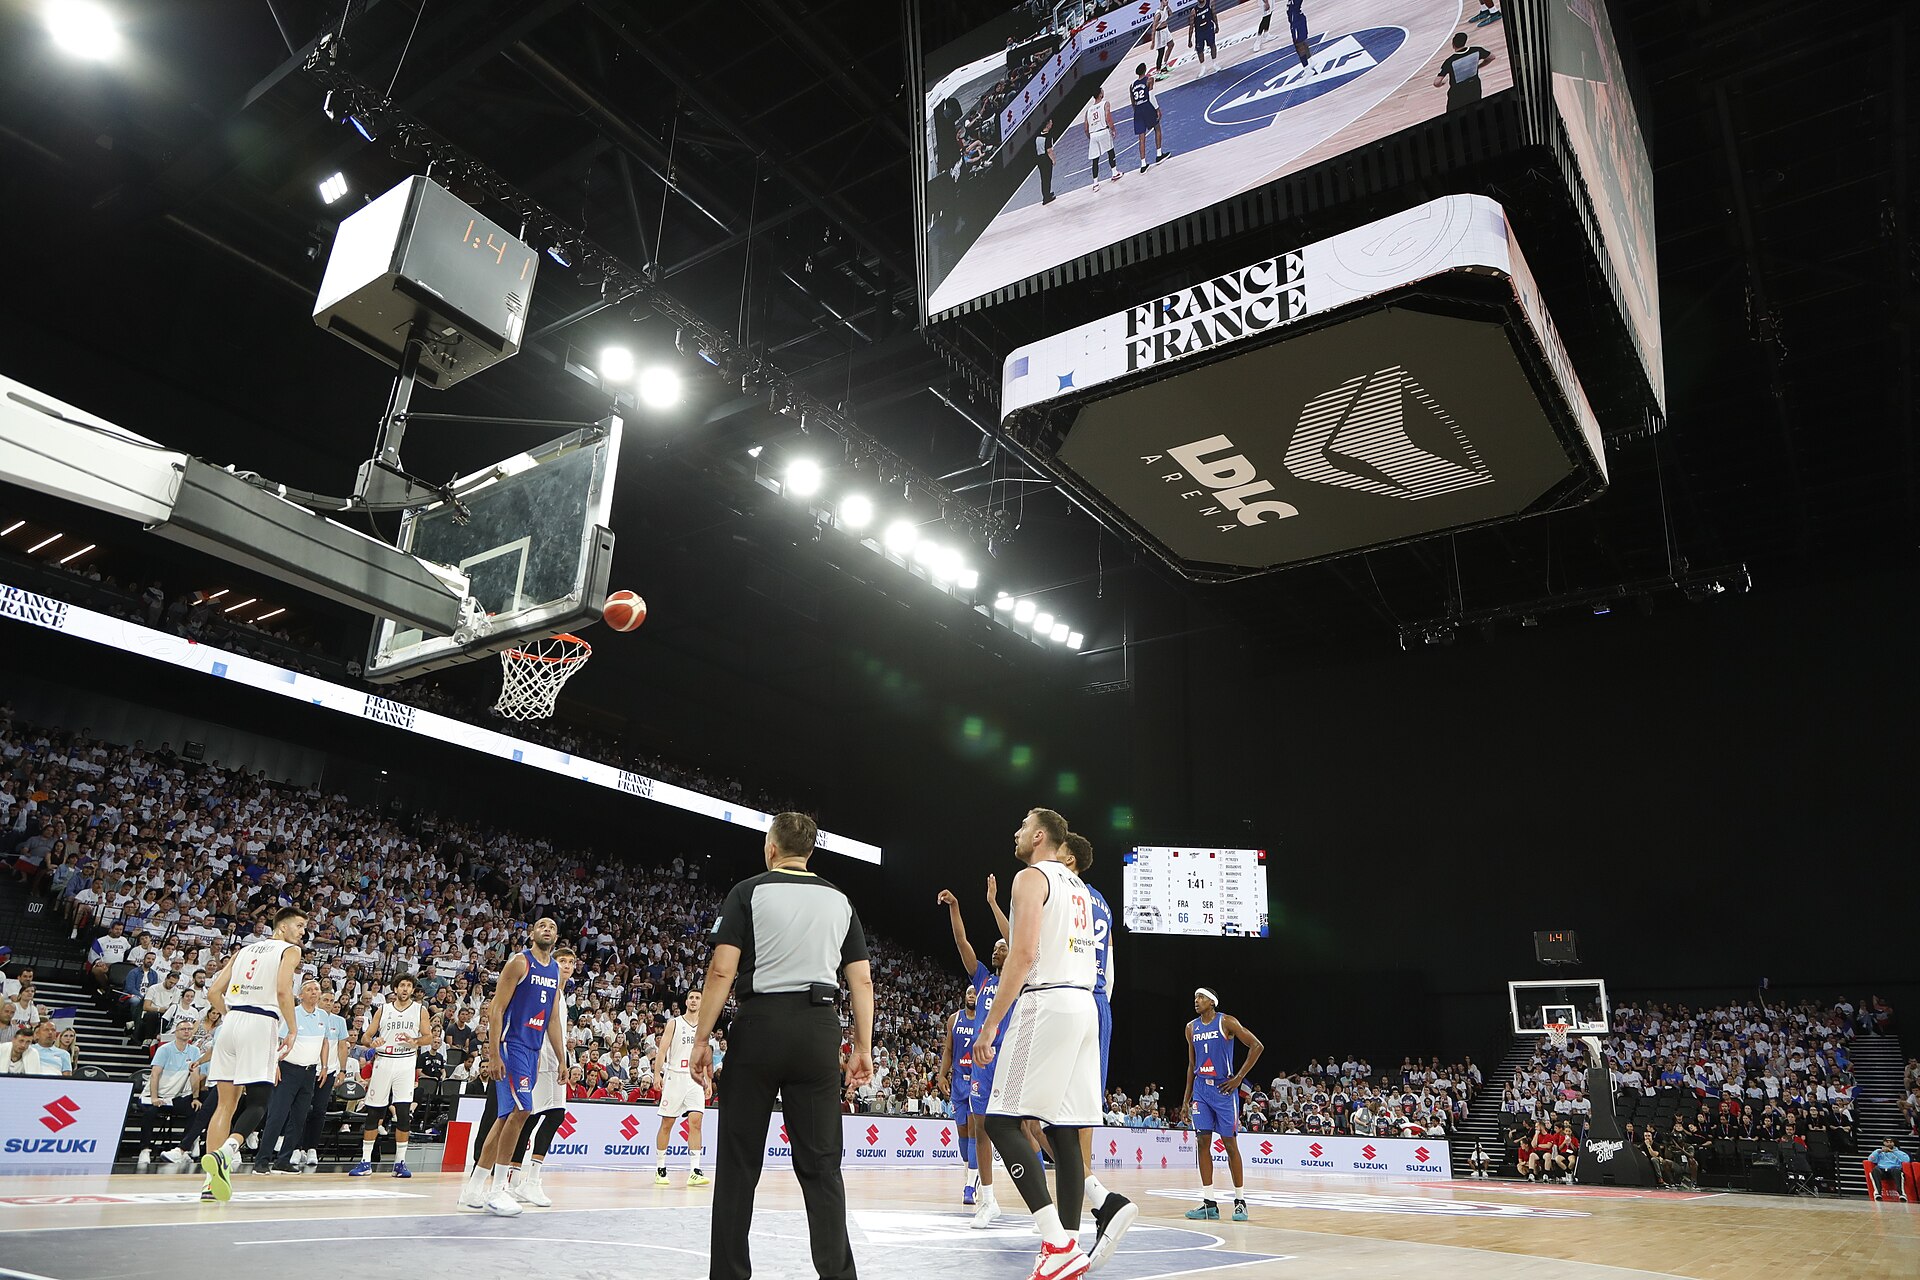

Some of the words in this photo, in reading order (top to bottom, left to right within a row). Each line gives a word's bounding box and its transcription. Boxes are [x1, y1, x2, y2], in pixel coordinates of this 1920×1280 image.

[1088, 29, 1117, 44] SUZUKI
[1133, 89, 1145, 100] 32
[463, 219, 531, 281] 1:41
[1125, 249, 1305, 339] FRANCE
[1125, 285, 1307, 372] FRANCE
[1166, 433, 1300, 527] LDLC
[1140, 453, 1238, 533] ARENA
[0, 585, 69, 615] RANCE
[0, 600, 65, 628] RANCE
[366, 694, 417, 718] FRANCE
[363, 705, 415, 729] FRANCE
[619, 770, 655, 788] FRANCE
[617, 779, 654, 797] FRANCE
[1187, 879, 1205, 889] 1:41
[27, 902, 43, 913] 007
[1177, 900, 1189, 908] FRA
[1202, 901, 1214, 909] SER
[1071, 894, 1087, 930] 33
[1178, 912, 1189, 924] 66
[1203, 914, 1214, 924] 75
[1094, 918, 1108, 951] 2
[245, 959, 258, 980] 3
[530, 974, 557, 989] FRANCE
[540, 990, 547, 1004] 5
[984, 997, 993, 1011] 9
[387, 1021, 415, 1031] SRBIJA
[528, 1017, 545, 1027] MAIF
[956, 1026, 974, 1035] FRAN
[1193, 1030, 1219, 1042] FRANCE
[681, 1037, 694, 1045] SRB
[963, 1037, 971, 1048] 7
[1203, 1043, 1209, 1054] 1
[4, 1138, 98, 1153] SUZUKI
[547, 1144, 589, 1155] UZUKI
[603, 1144, 650, 1156] SUZUKI
[768, 1147, 793, 1157] SUZU
[856, 1148, 887, 1158] SUZUKI
[896, 1149, 925, 1158] SUZUKI
[932, 1150, 958, 1158] SUZUKI
[1251, 1157, 1283, 1165] SUZUKI
[1300, 1159, 1334, 1168] SUZUKI
[1353, 1161, 1388, 1170] SUZUKI
[1405, 1164, 1442, 1173] SUZUKI
